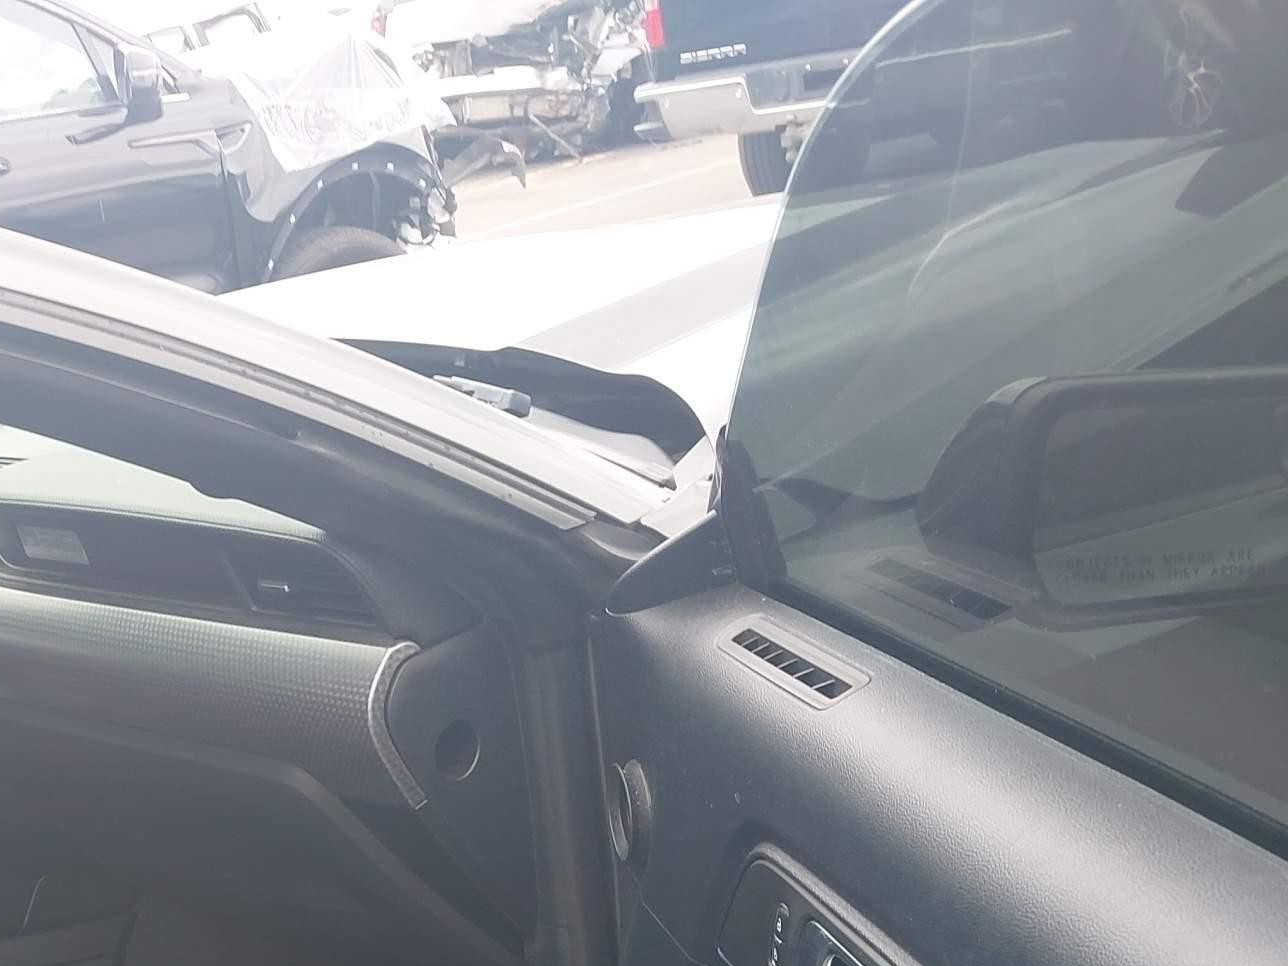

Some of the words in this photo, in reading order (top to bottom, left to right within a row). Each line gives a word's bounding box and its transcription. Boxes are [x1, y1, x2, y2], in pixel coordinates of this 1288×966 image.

[680, 43, 746, 65] SIERRA
[1055, 570, 1108, 585] CLO
[1210, 563, 1272, 578] APP
